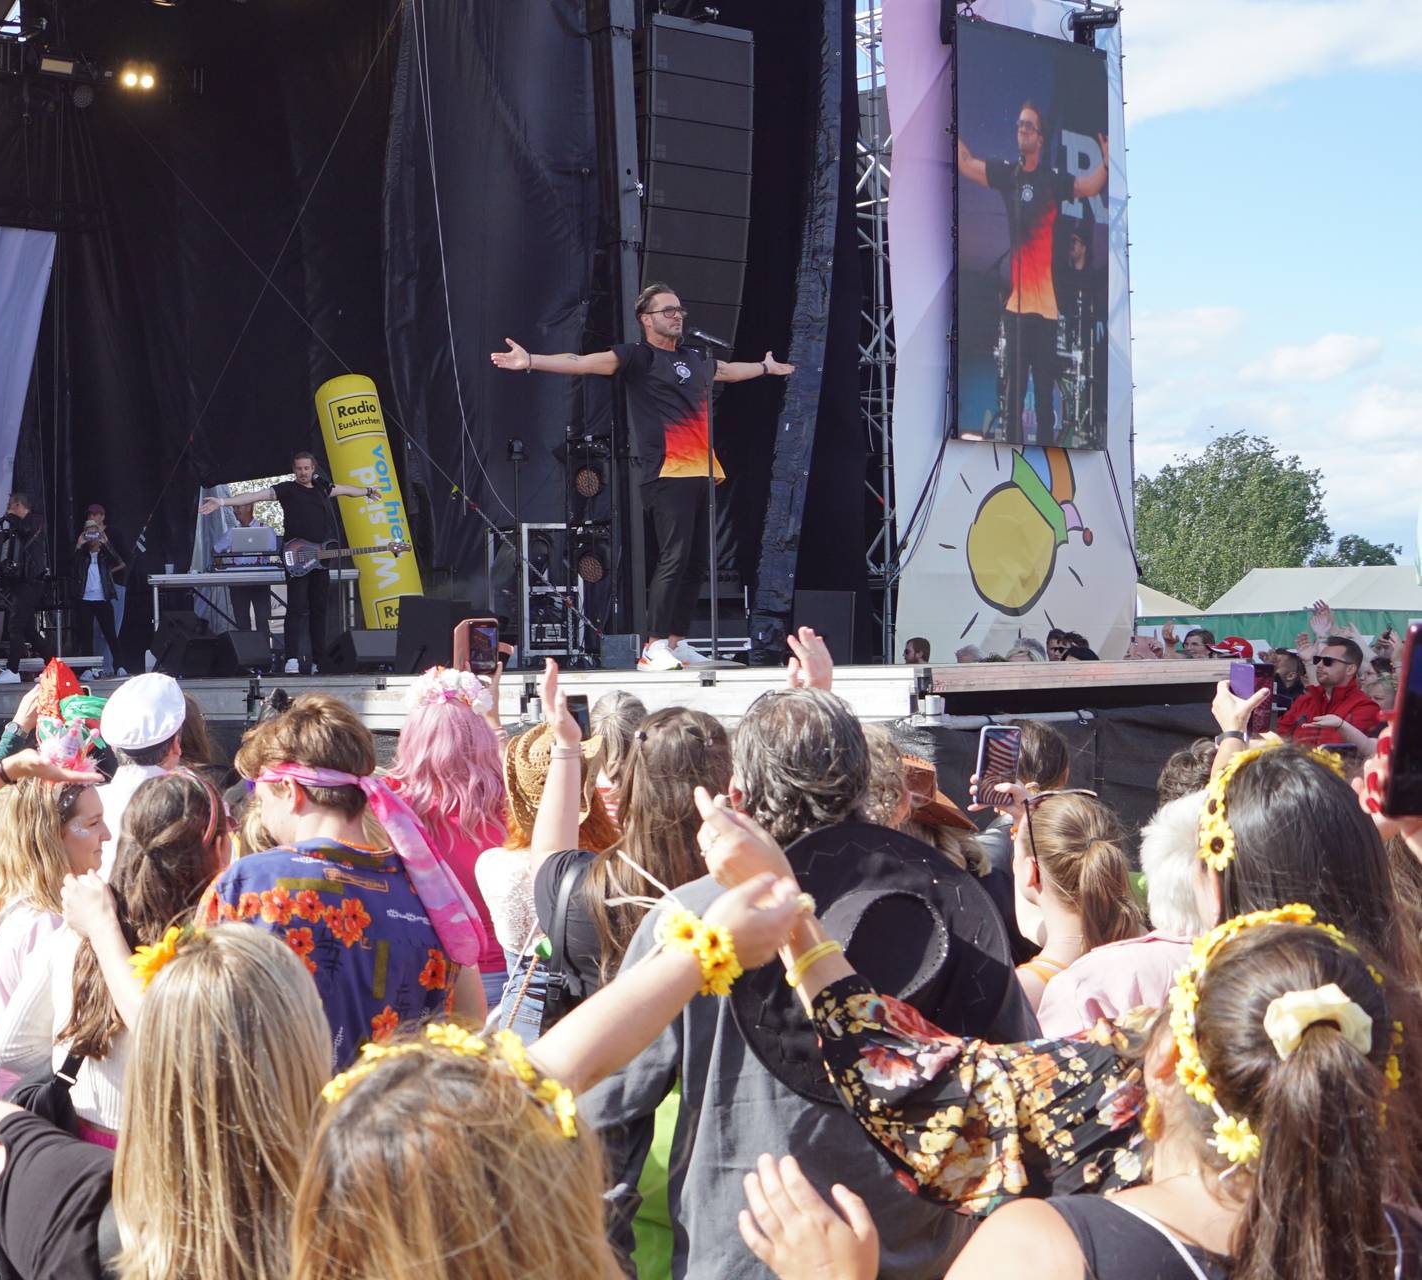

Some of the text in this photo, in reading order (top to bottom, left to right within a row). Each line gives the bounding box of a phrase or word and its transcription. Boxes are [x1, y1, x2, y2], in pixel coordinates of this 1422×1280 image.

[337, 401, 377, 418] Radio
[338, 417, 381, 430] Euskirchen
[349, 466, 386, 524] sid
[372, 443, 404, 546] von hie
